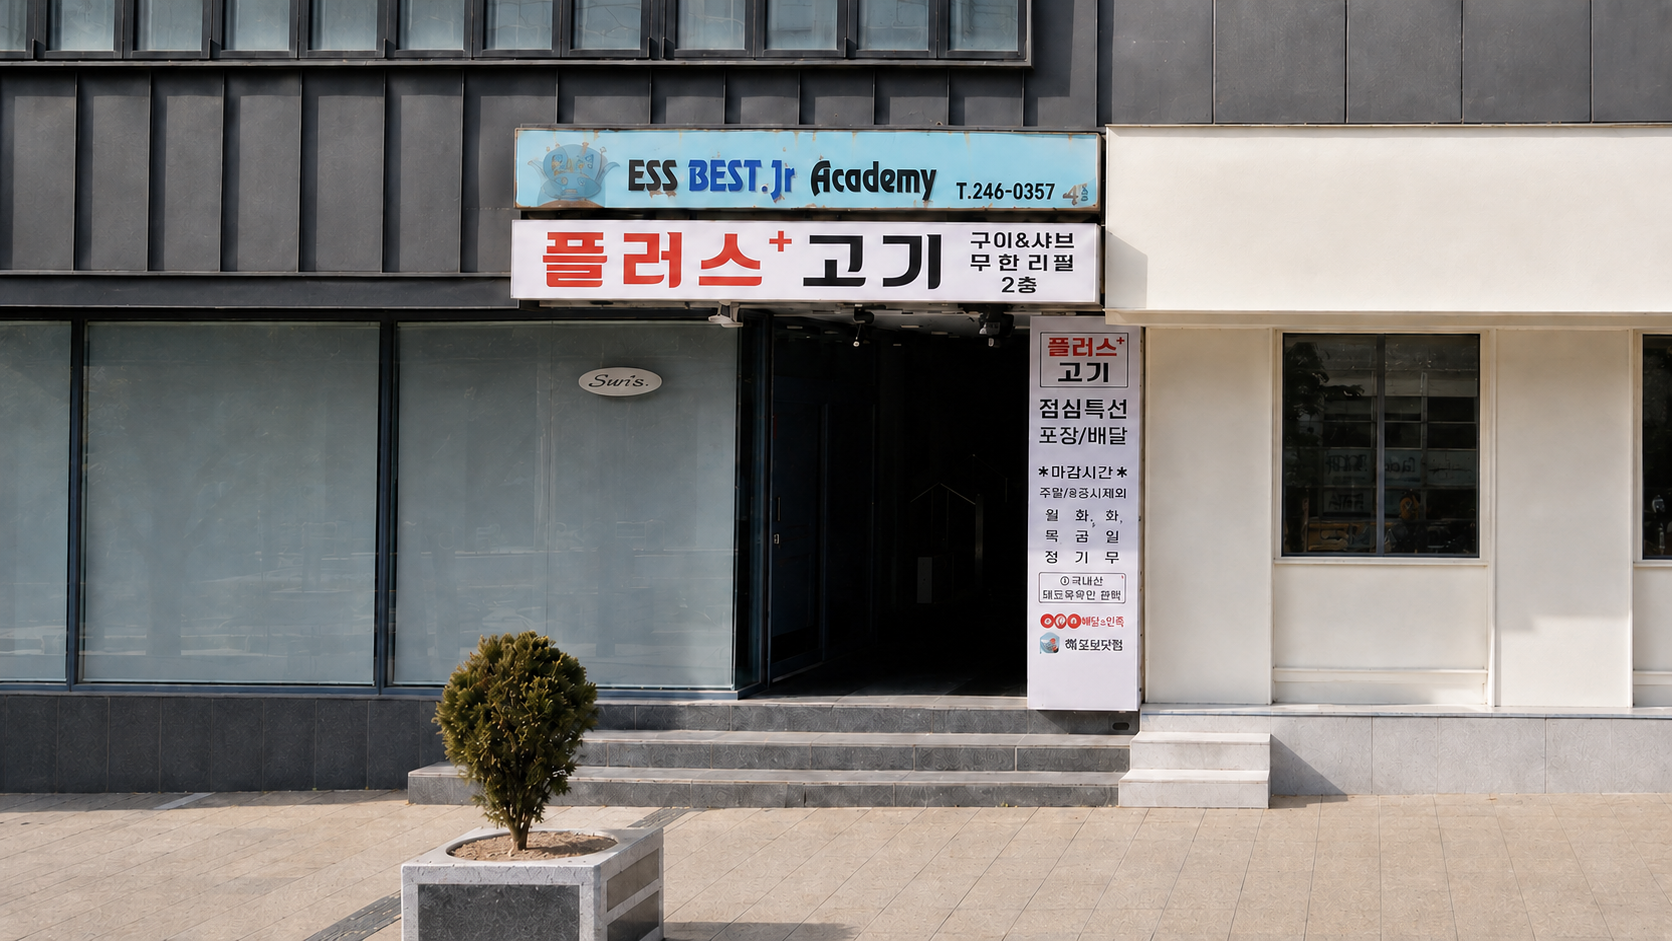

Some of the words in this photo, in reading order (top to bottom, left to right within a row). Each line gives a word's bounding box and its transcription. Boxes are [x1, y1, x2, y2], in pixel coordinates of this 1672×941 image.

[628, 159, 678, 192] ESS
[688, 159, 796, 202] BEST.Jr
[811, 160, 937, 201] Academy
[956, 182, 1056, 200] T.246-0357
[970, 232, 1075, 249] 구이&샤브
[803, 234, 943, 289] 고기
[1057, 362, 1109, 383] 고기
[1039, 399, 1127, 419] 점심특선
[1039, 427, 1128, 445] 포장/배달
[1105, 529, 1119, 544] 일
[1045, 550, 1058, 564] 정
[1075, 551, 1088, 564] 기
[1104, 551, 1119, 564] 무
